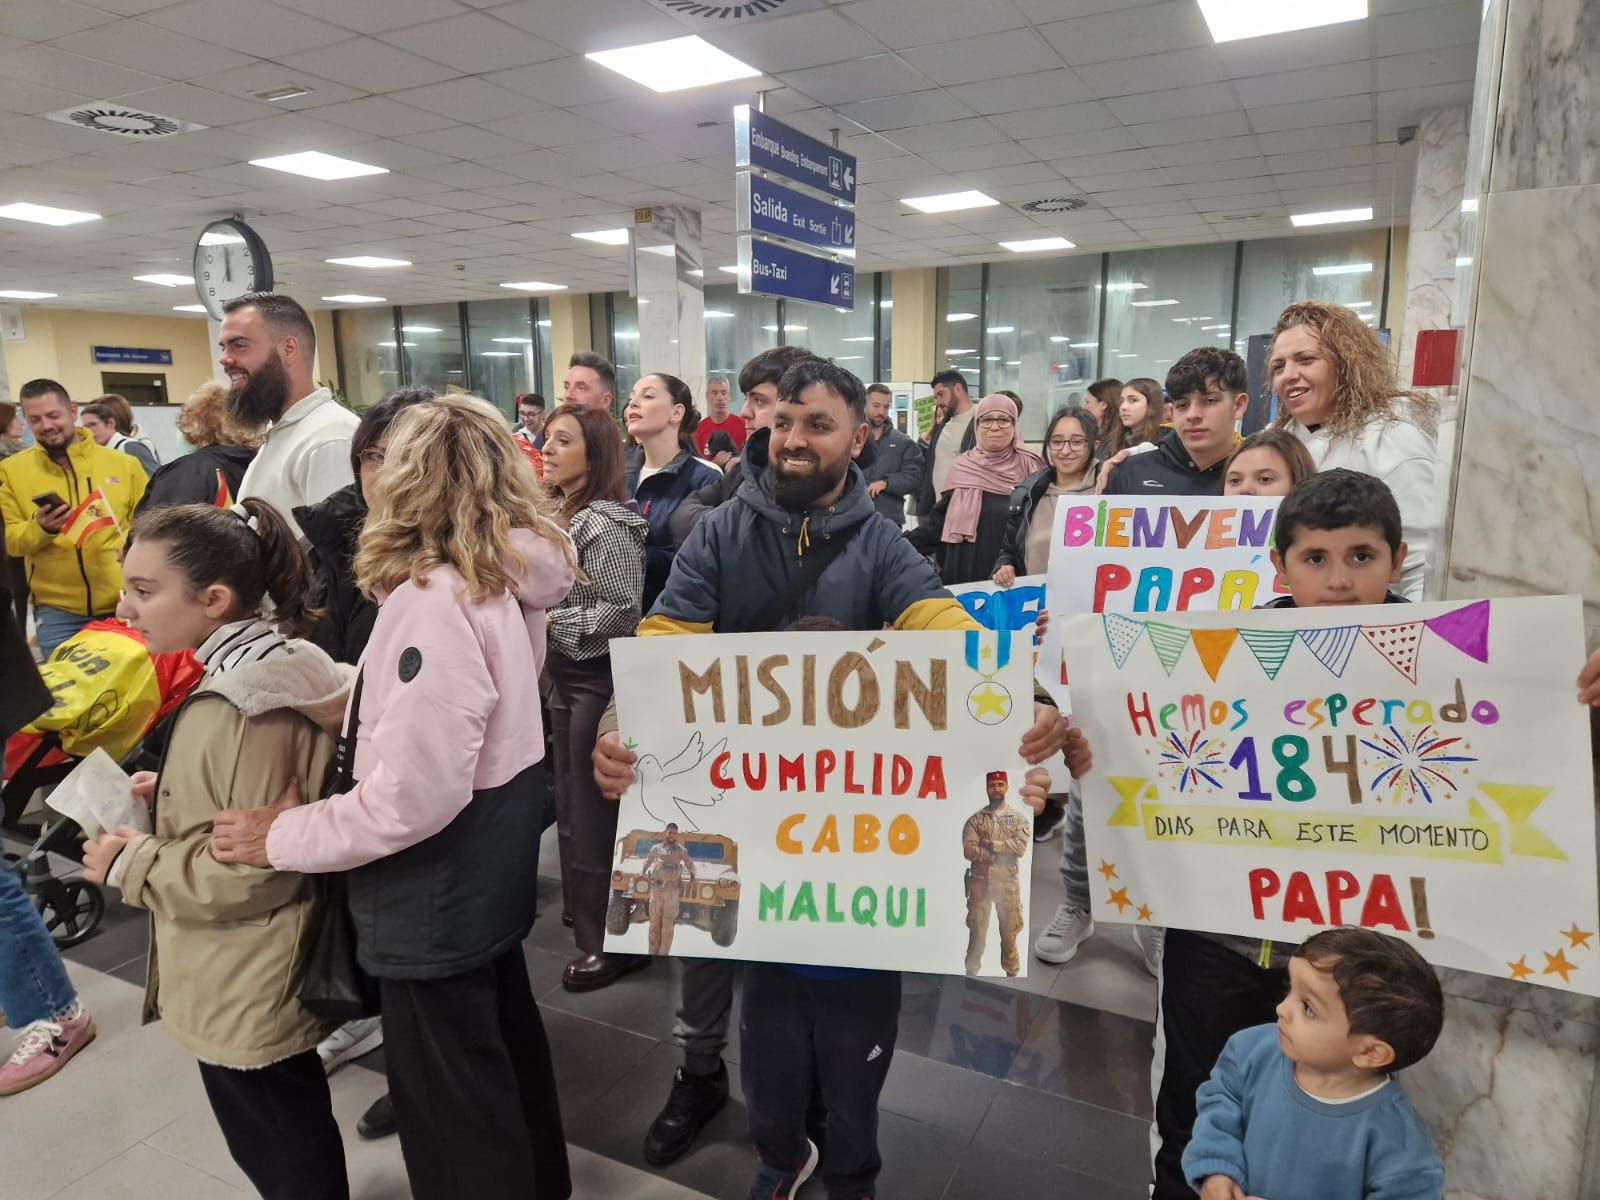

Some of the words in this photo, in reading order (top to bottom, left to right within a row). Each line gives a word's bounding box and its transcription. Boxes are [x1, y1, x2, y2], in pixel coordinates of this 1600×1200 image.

[752, 127, 779, 157] Embarque
[753, 192, 788, 222] Salida
[793, 214, 806, 228] Exit
[809, 219, 827, 235] Sortie
[203, 254, 213, 264] 10
[243, 247, 250, 257] 2
[247, 265, 255, 275] 3
[753, 260, 787, 280] Bus-Taxi
[203, 271, 211, 281] 9
[208, 287, 216, 296] 8
[1093, 554, 1262, 613] PAPÁ
[679, 637, 948, 731] MISIÓN
[1127, 691, 1248, 737] Hemos
[1283, 678, 1500, 730] esperado
[709, 749, 948, 800] CUMPLIDA
[1229, 734, 1363, 804] 184
[775, 813, 920, 855] CABO
[1155, 815, 1194, 837] DIAS
[1217, 817, 1272, 840] PARA
[1296, 821, 1356, 844] ESTE
[1379, 824, 1490, 851] MOMENTO
[758, 880, 926, 929] MALQUI
[1248, 867, 1435, 940] PAPA!
